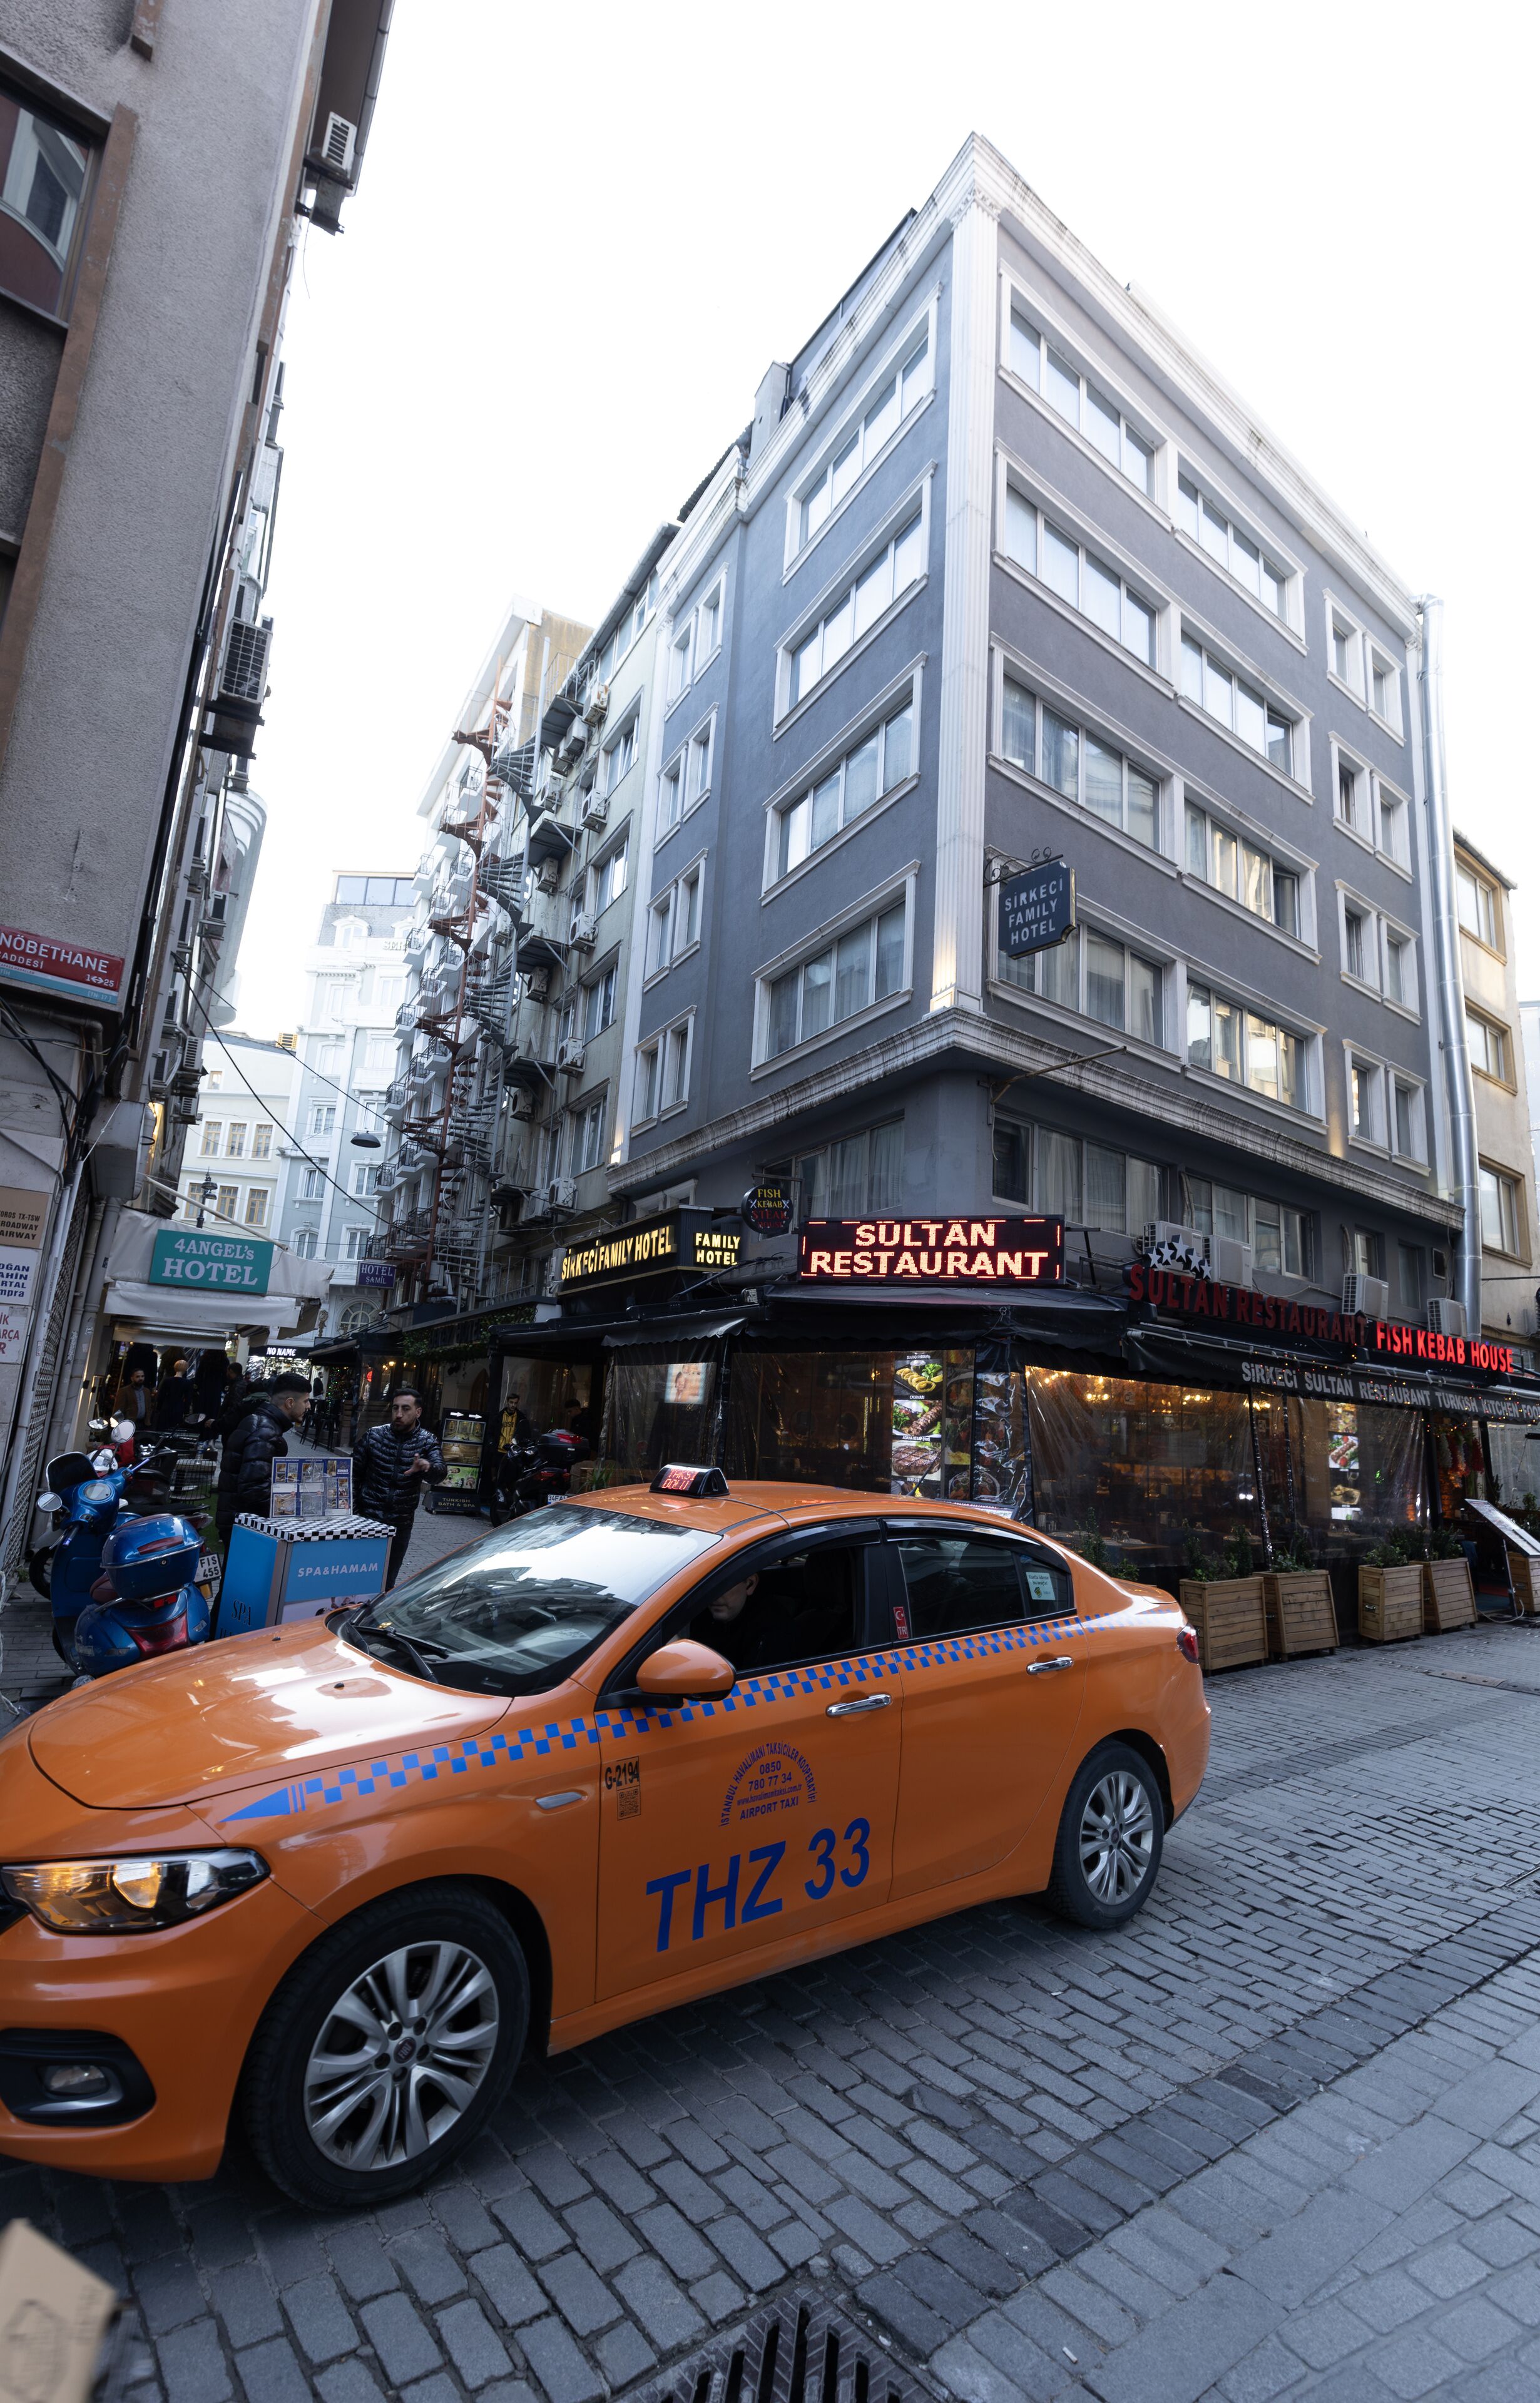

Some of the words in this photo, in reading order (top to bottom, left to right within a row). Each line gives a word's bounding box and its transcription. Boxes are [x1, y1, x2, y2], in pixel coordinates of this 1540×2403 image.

[1005, 875, 1063, 911] SİRKECİ
[1009, 898, 1058, 928] FAMILY
[1011, 919, 1056, 945] HOTEL
[0, 932, 110, 974] NÖBETHANE
[103, 979, 114, 987] 25
[758, 1189, 781, 1198] FISH
[0, 1220, 39, 1231] ROADWAY
[752, 1210, 787, 1220] STEAK
[695, 1233, 741, 1249] FAMILY
[855, 1223, 996, 1247] SULTAN
[599, 1237, 633, 1271] FAMILY
[634, 1225, 672, 1262] HOTEL
[696, 1249, 738, 1265] HOTEL
[161, 1257, 258, 1285] HOTEL
[361, 1264, 392, 1277] HOTEL
[810, 1252, 1049, 1275] RESTAURANT
[365, 1276, 386, 1285] ŞAMİL
[1129, 1263, 1228, 1319] SULTAN
[1236, 1288, 1367, 1347] RESTAURANT
[266, 1347, 276, 1355] NO
[277, 1347, 297, 1357] NAME
[1376, 1321, 1413, 1355] FISH
[1417, 1329, 1466, 1364] KEBAB
[1471, 1341, 1514, 1373] HOUSE
[1305, 1372, 1354, 1397] SULTAN
[1358, 1381, 1432, 1407] RESTAURANT
[200, 1556, 217, 1568] FIS
[203, 1566, 219, 1578] 455
[298, 1563, 378, 1578] SPA&HAMAM
[232, 1599, 251, 1626] SPA
[605, 1760, 640, 1790] G-2194
[760, 1760, 782, 1775] 0850
[748, 1778, 765, 1792] 780
[767, 1775, 779, 1787] 77
[781, 1772, 792, 1783] 34
[719, 1784, 737, 1827] İSTANBUL
[740, 1801, 778, 1820] AIRPORT
[780, 1796, 799, 1810] TAXI
[646, 1840, 786, 1952] THZ
[804, 1817, 870, 1900] 33
